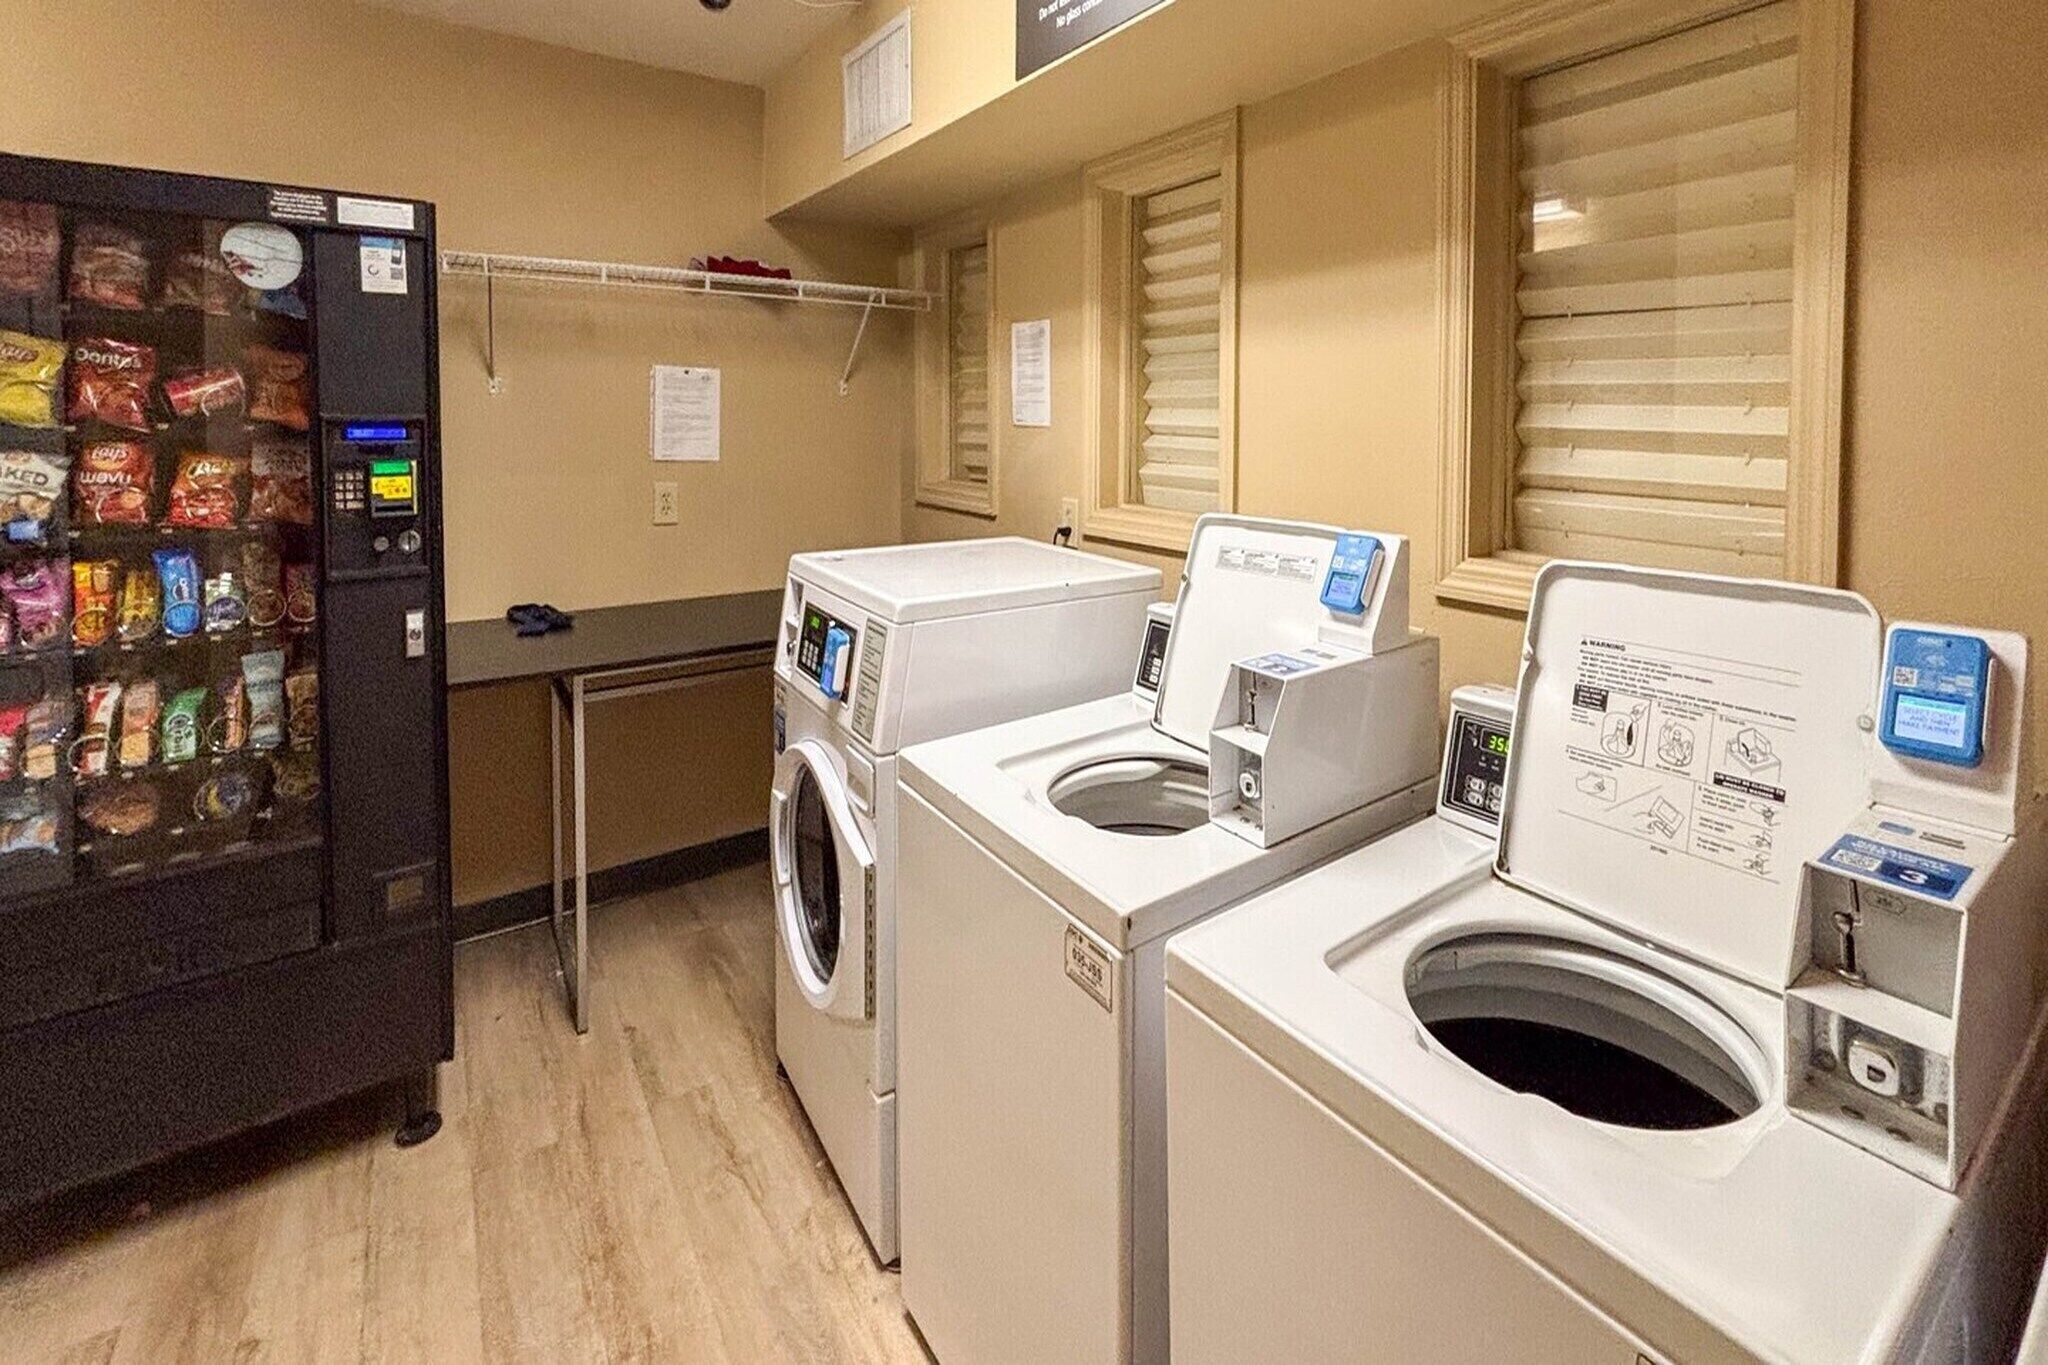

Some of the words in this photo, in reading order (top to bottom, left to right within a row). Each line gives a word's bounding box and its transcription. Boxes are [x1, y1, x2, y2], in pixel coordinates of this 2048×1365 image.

[1056, 15, 1066, 28] No
[1066, 5, 1081, 26] glass
[0, 465, 49, 487] KED
[1589, 640, 1626, 652] WARNING
